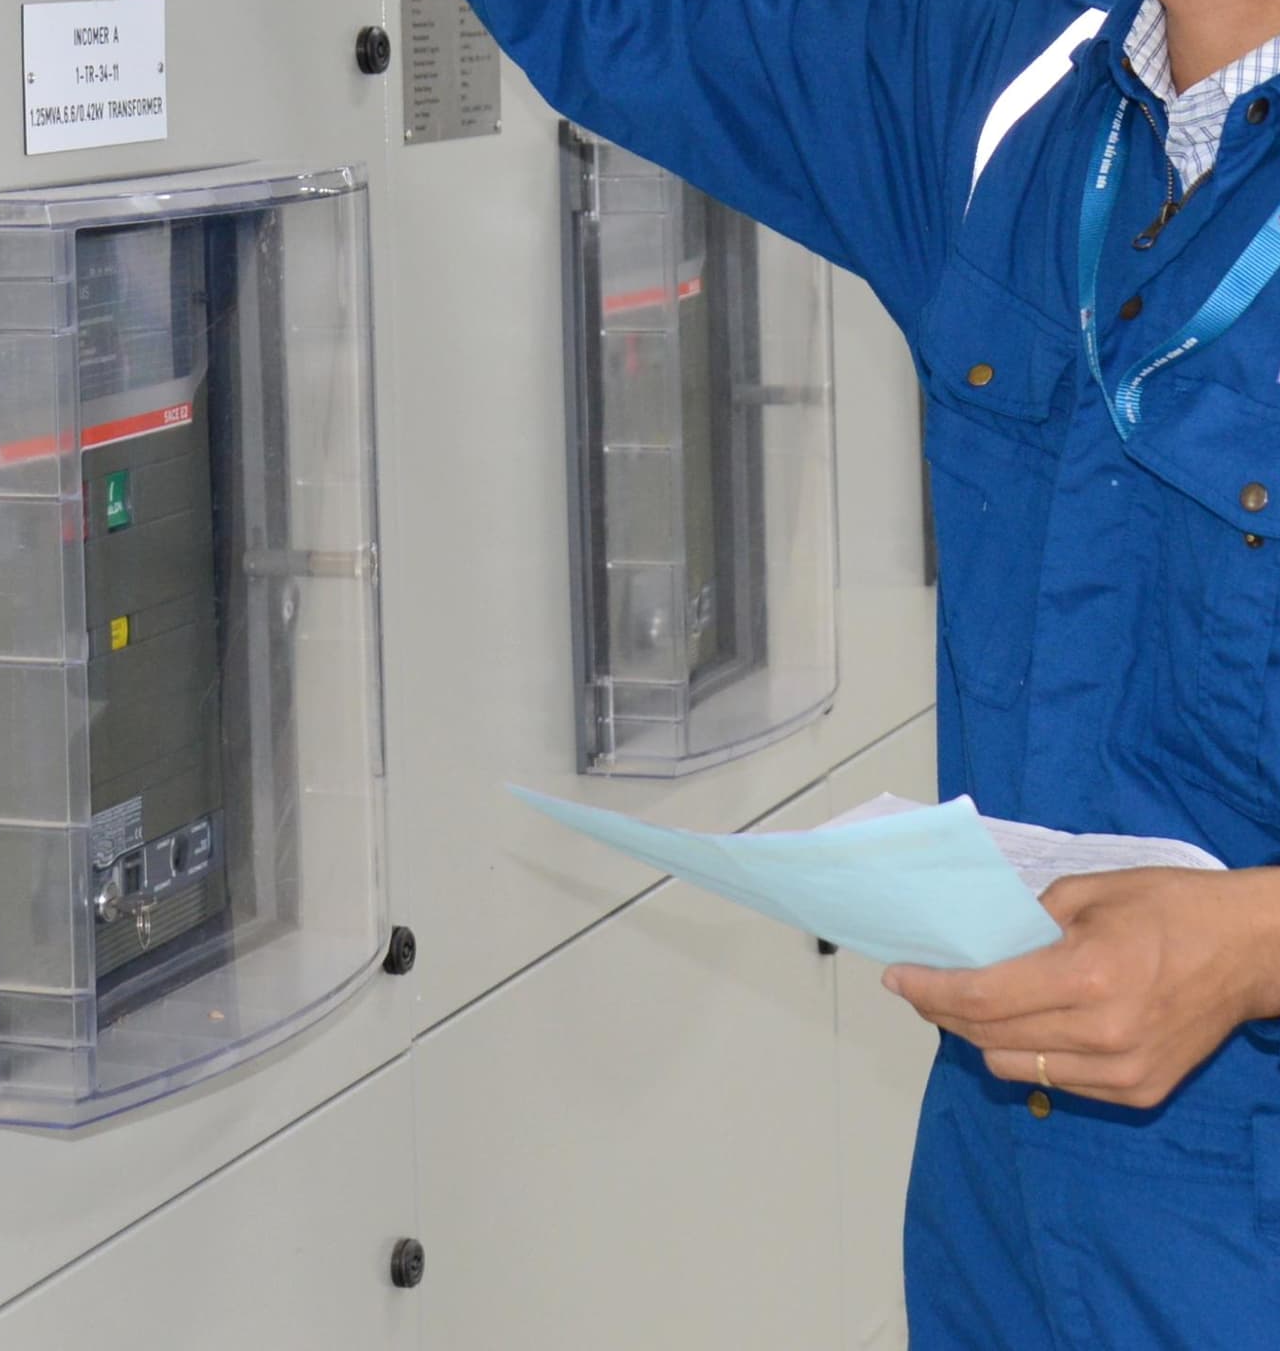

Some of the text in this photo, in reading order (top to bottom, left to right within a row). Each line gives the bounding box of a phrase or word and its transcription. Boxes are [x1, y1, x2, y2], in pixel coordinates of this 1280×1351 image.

[73, 25, 120, 47] INCOMER A
[108, 97, 164, 120] TRANSFORMER
